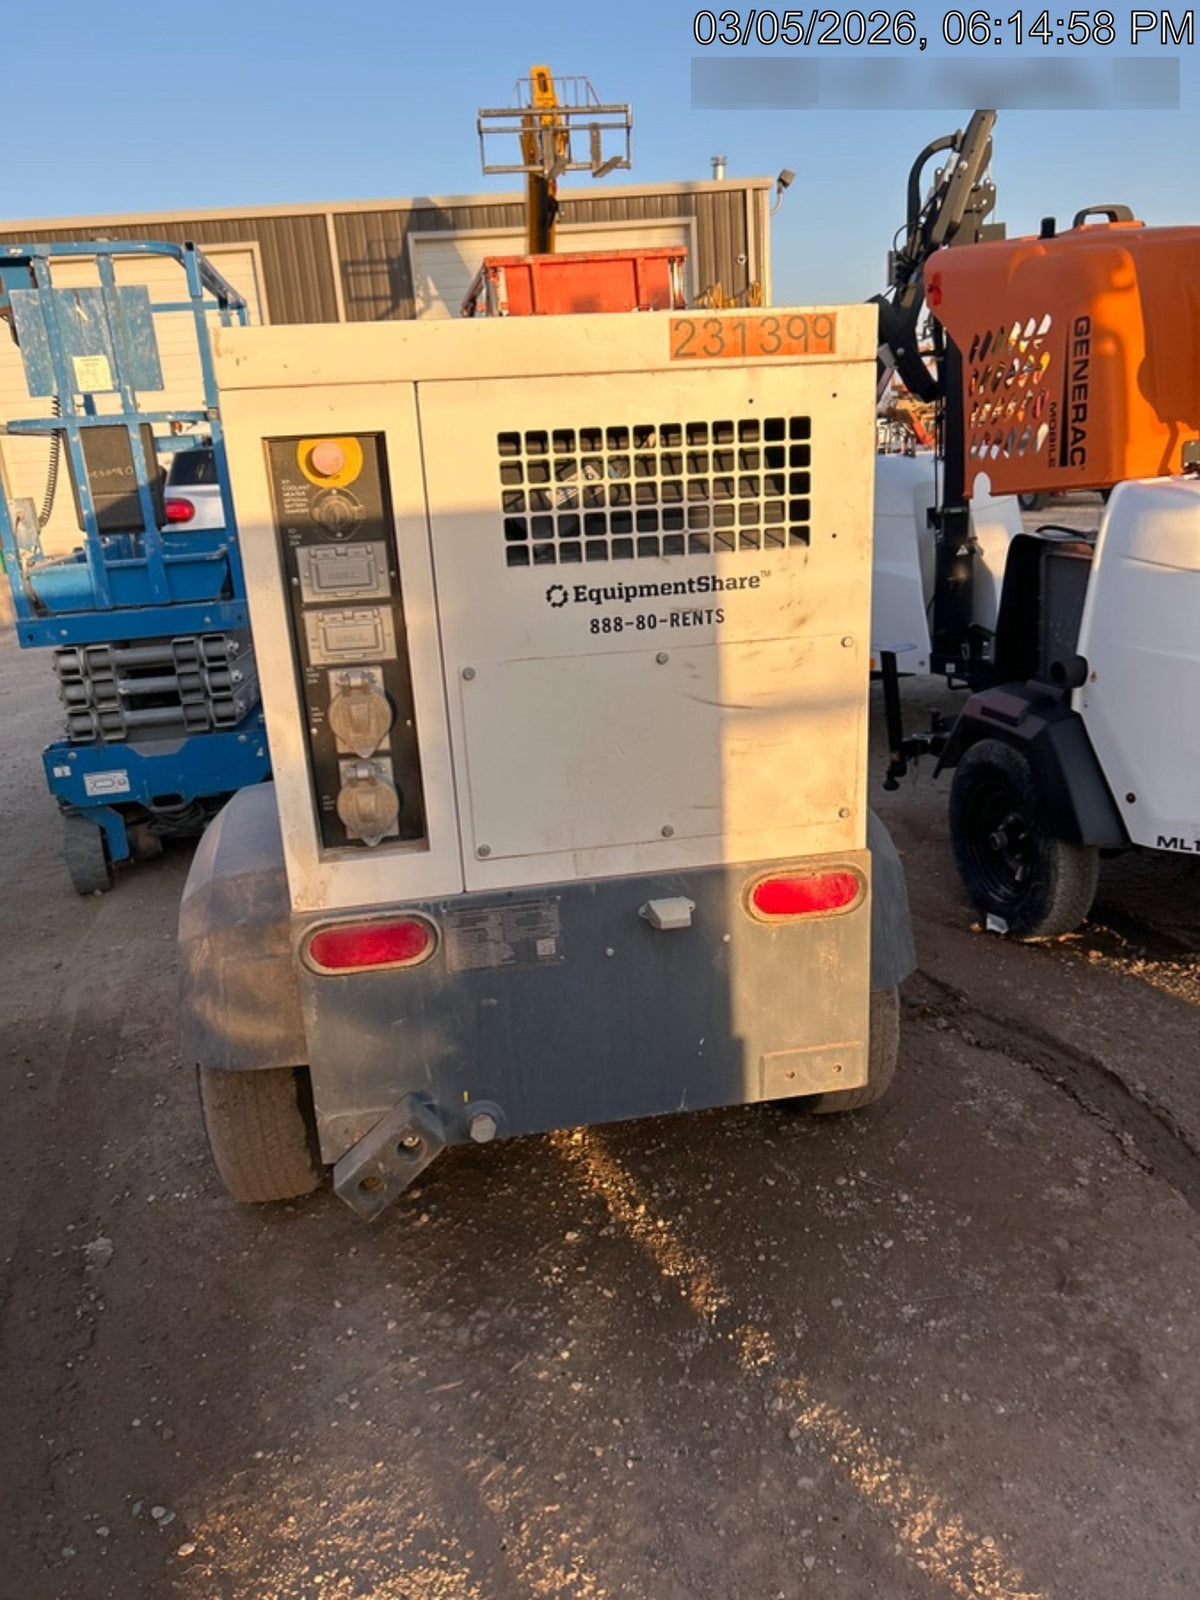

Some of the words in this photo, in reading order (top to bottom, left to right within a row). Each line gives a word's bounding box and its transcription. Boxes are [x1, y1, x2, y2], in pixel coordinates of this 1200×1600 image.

[673, 313, 834, 358] 231399
[1069, 316, 1090, 467] GENERAC
[589, 608, 726, 634] 888-80-RENTS
